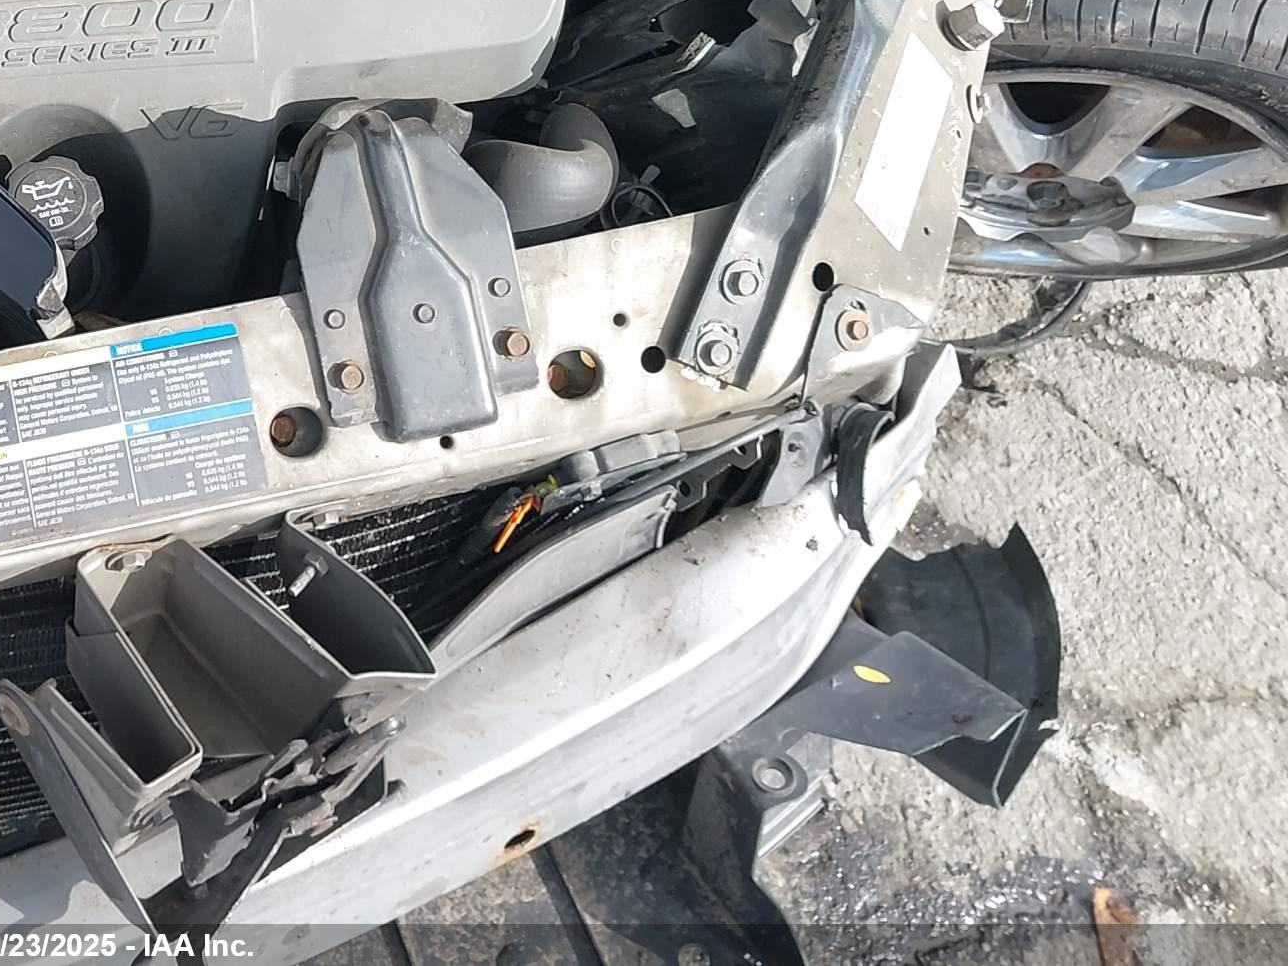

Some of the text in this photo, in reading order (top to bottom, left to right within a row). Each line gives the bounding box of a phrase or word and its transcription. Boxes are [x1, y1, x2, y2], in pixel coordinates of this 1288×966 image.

[0, 34, 222, 68] SERIES III
[140, 102, 245, 140] V6
